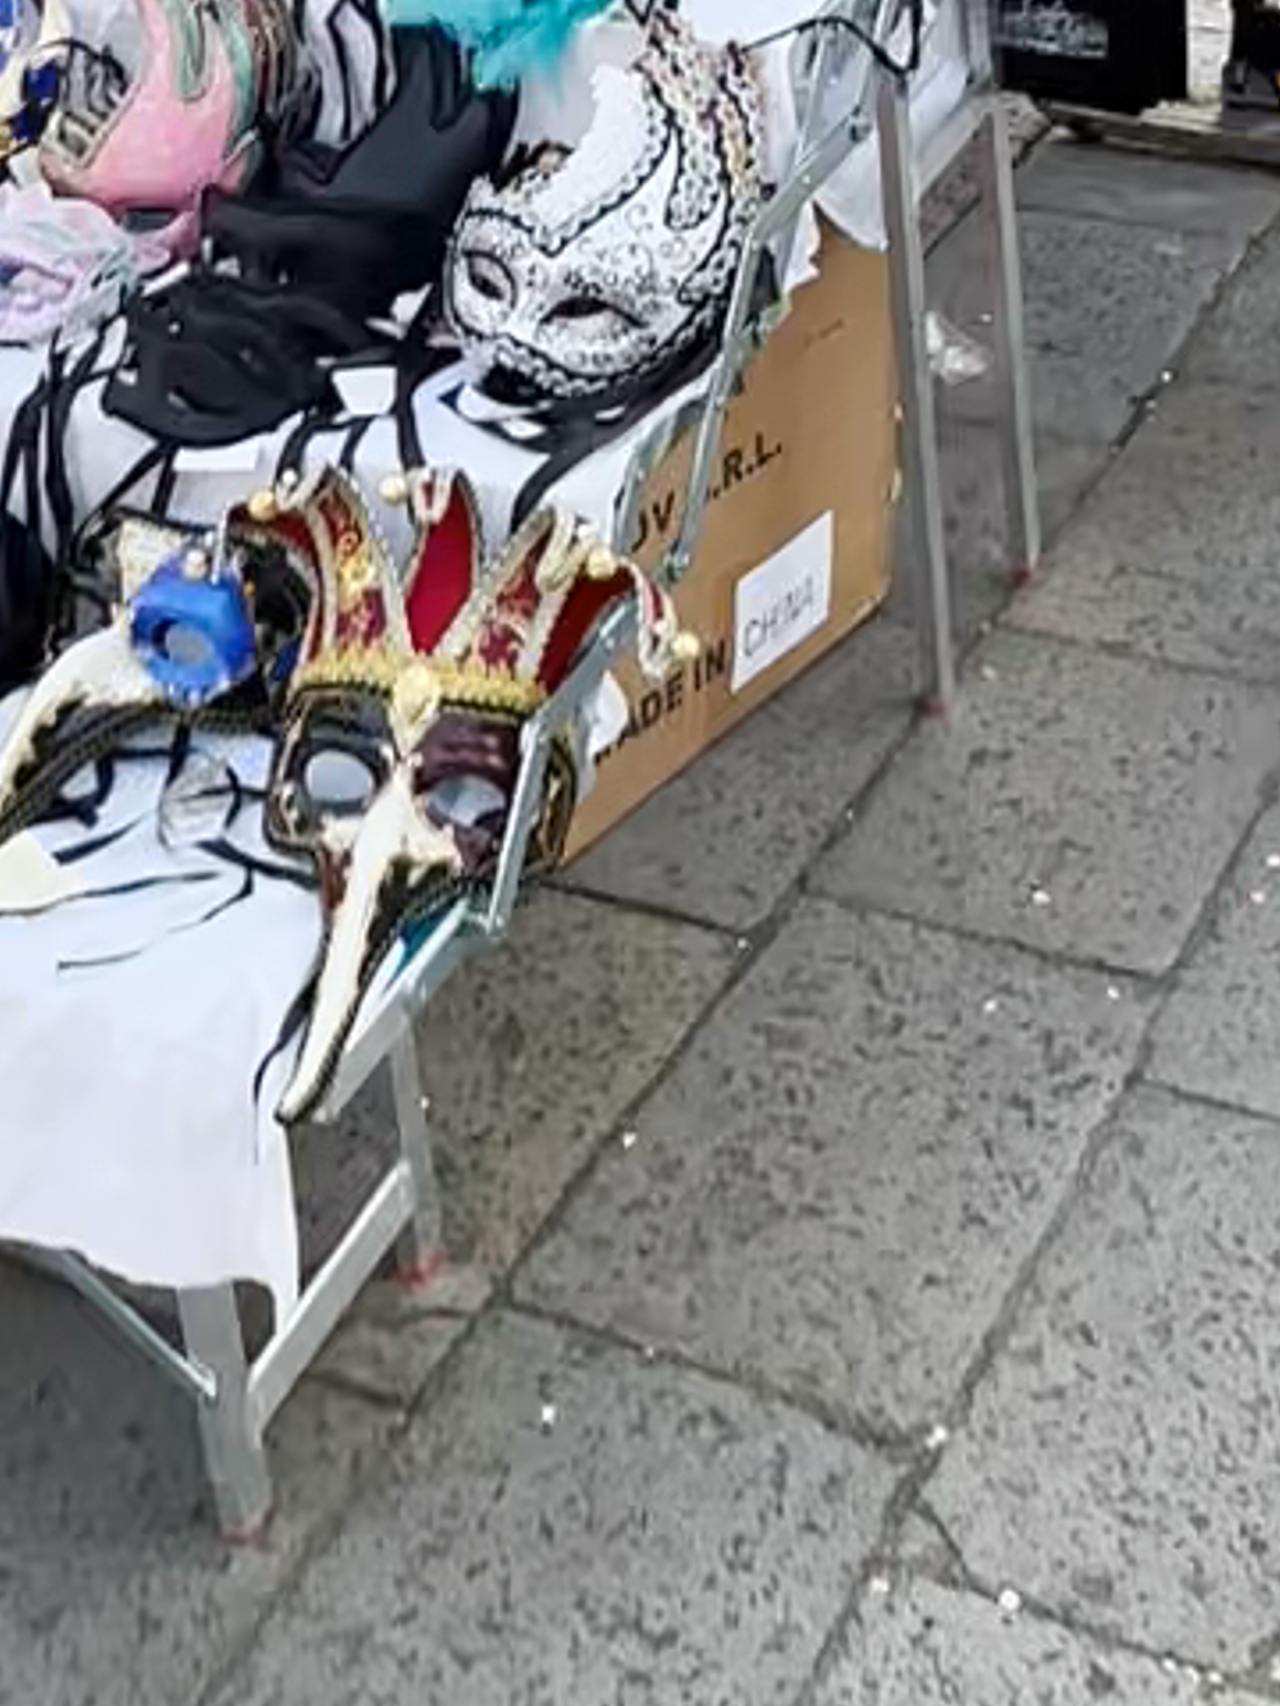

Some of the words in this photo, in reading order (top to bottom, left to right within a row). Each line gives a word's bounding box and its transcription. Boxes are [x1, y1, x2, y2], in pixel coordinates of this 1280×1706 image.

[704, 431, 783, 500] .R.L.
[595, 669, 683, 767] ADE
[694, 638, 726, 692] IN
